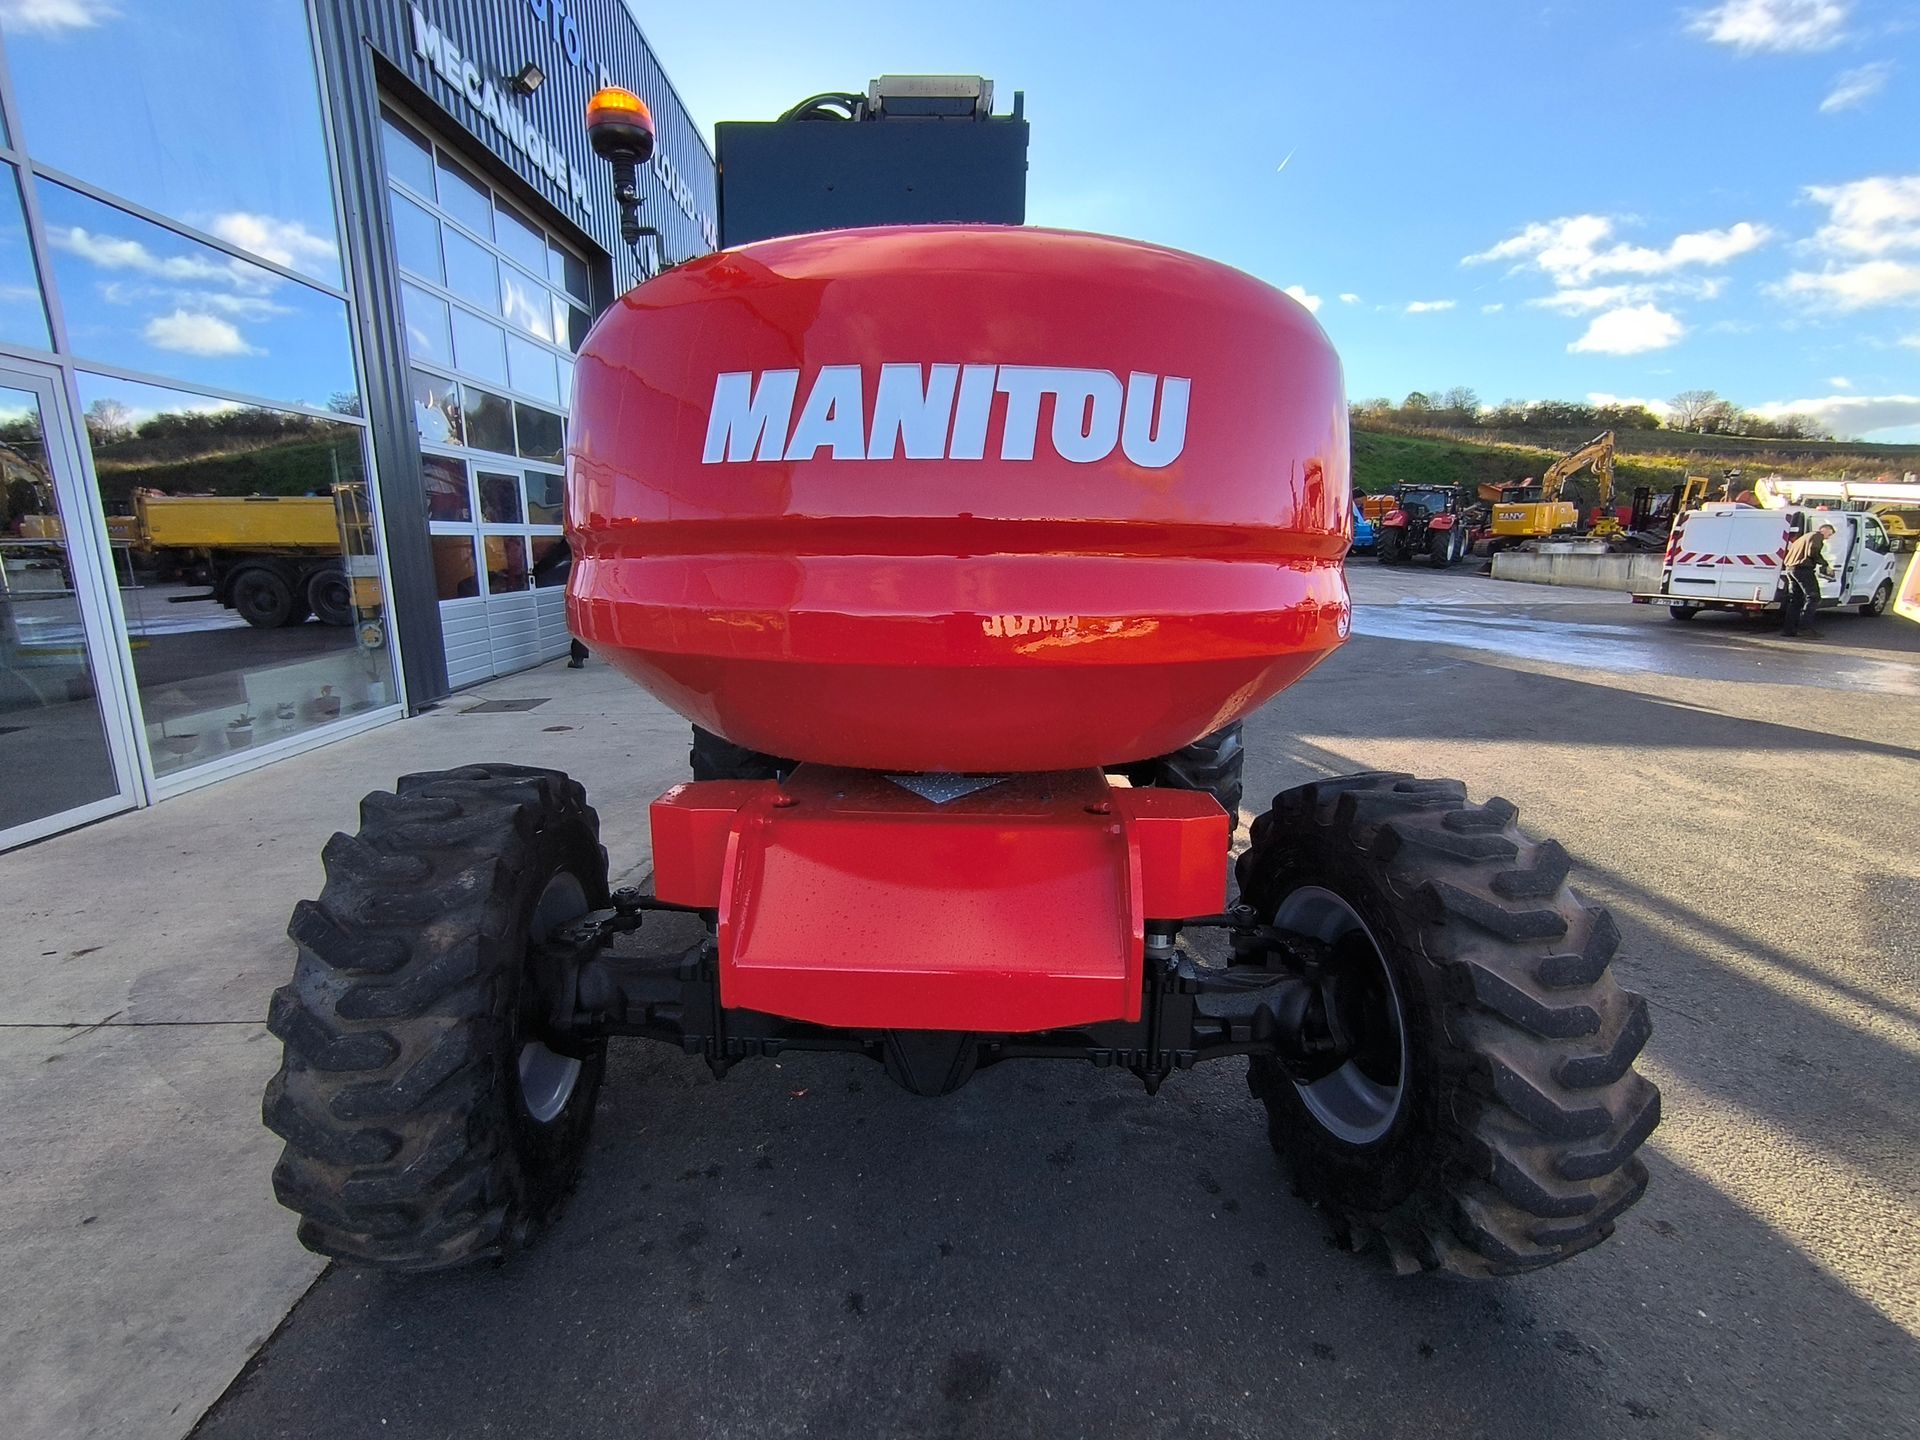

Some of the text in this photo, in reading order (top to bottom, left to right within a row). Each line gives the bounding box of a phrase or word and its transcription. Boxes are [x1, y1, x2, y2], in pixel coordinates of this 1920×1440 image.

[411, 4, 568, 193] MECANIQUE
[654, 152, 695, 220] LOURD
[701, 362, 1192, 468] MANITOU
[1498, 512, 1526, 520] SANY
